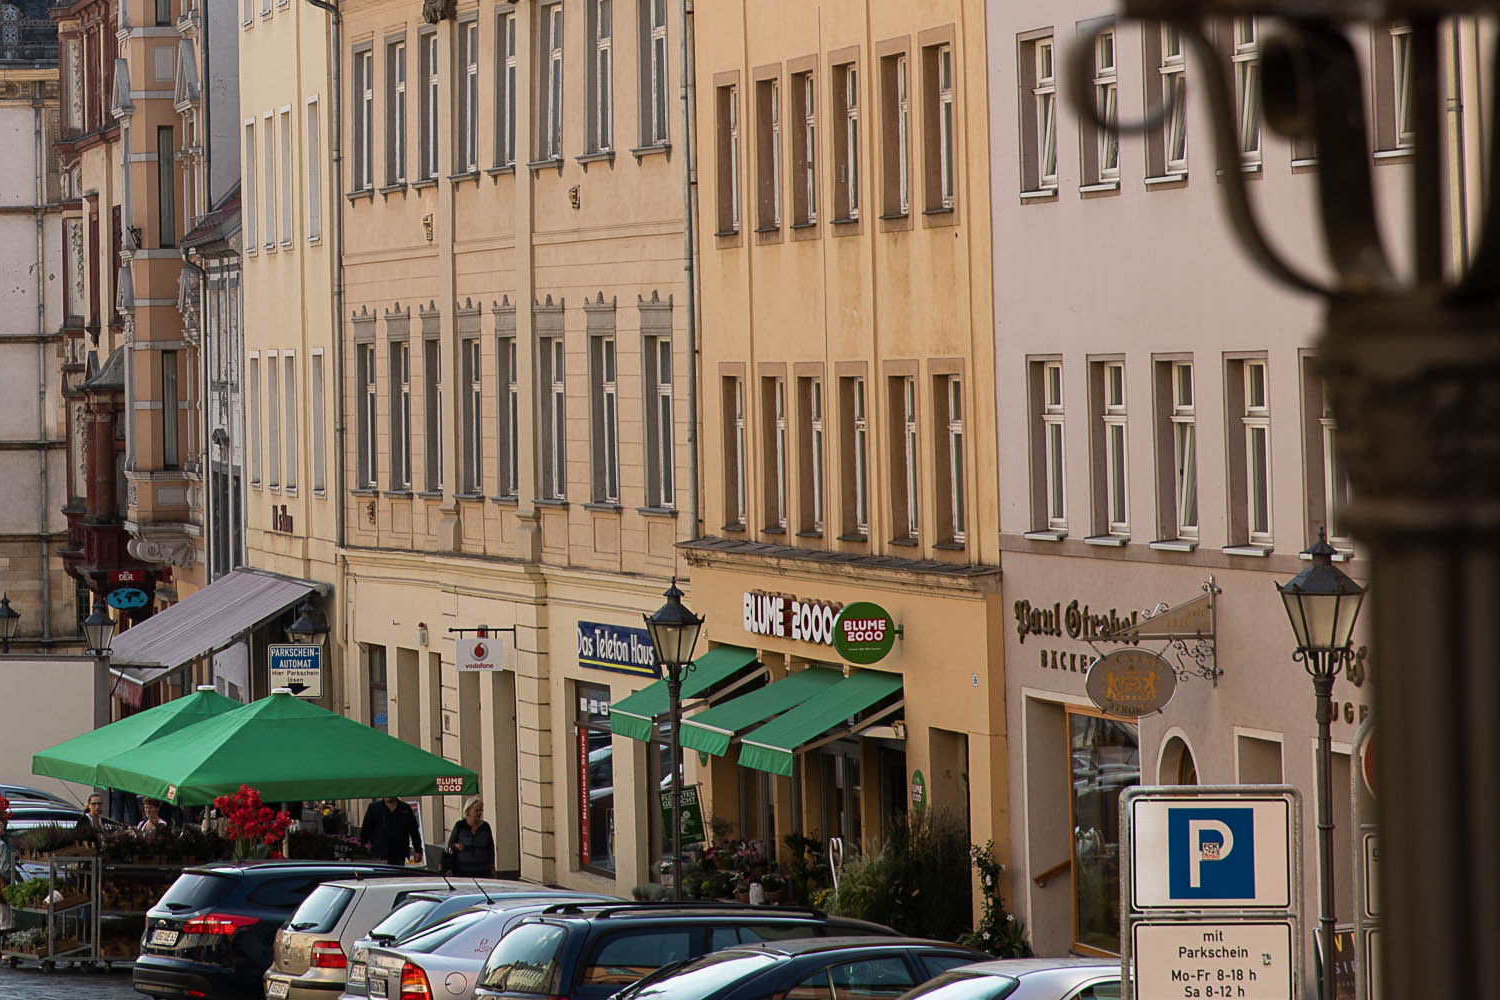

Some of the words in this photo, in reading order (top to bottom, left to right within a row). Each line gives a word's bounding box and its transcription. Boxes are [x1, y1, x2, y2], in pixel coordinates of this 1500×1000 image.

[743, 592, 785, 637] BLUME
[791, 601, 834, 646] 2000
[843, 619, 887, 632] BLUME
[1014, 599, 1062, 645] Paul
[847, 631, 884, 642] 2000
[271, 648, 319, 657] PARKSCHEIN-
[594, 628, 629, 662] Telefon
[630, 633, 655, 666] Haus
[279, 659, 312, 668] AUTOMAT
[436, 777, 463, 785] BLUME
[1189, 819, 1234, 888] P
[1203, 930, 1224, 942] mit
[1178, 946, 1249, 959] Parkschein
[1171, 969, 1211, 982] Mo-Fr
[1217, 969, 1244, 981] 8-18
[1249, 969, 1257, 981] h
[1184, 986, 1200, 998] Sa
[1205, 986, 1232, 998] 8-12
[1237, 986, 1245, 998] h
